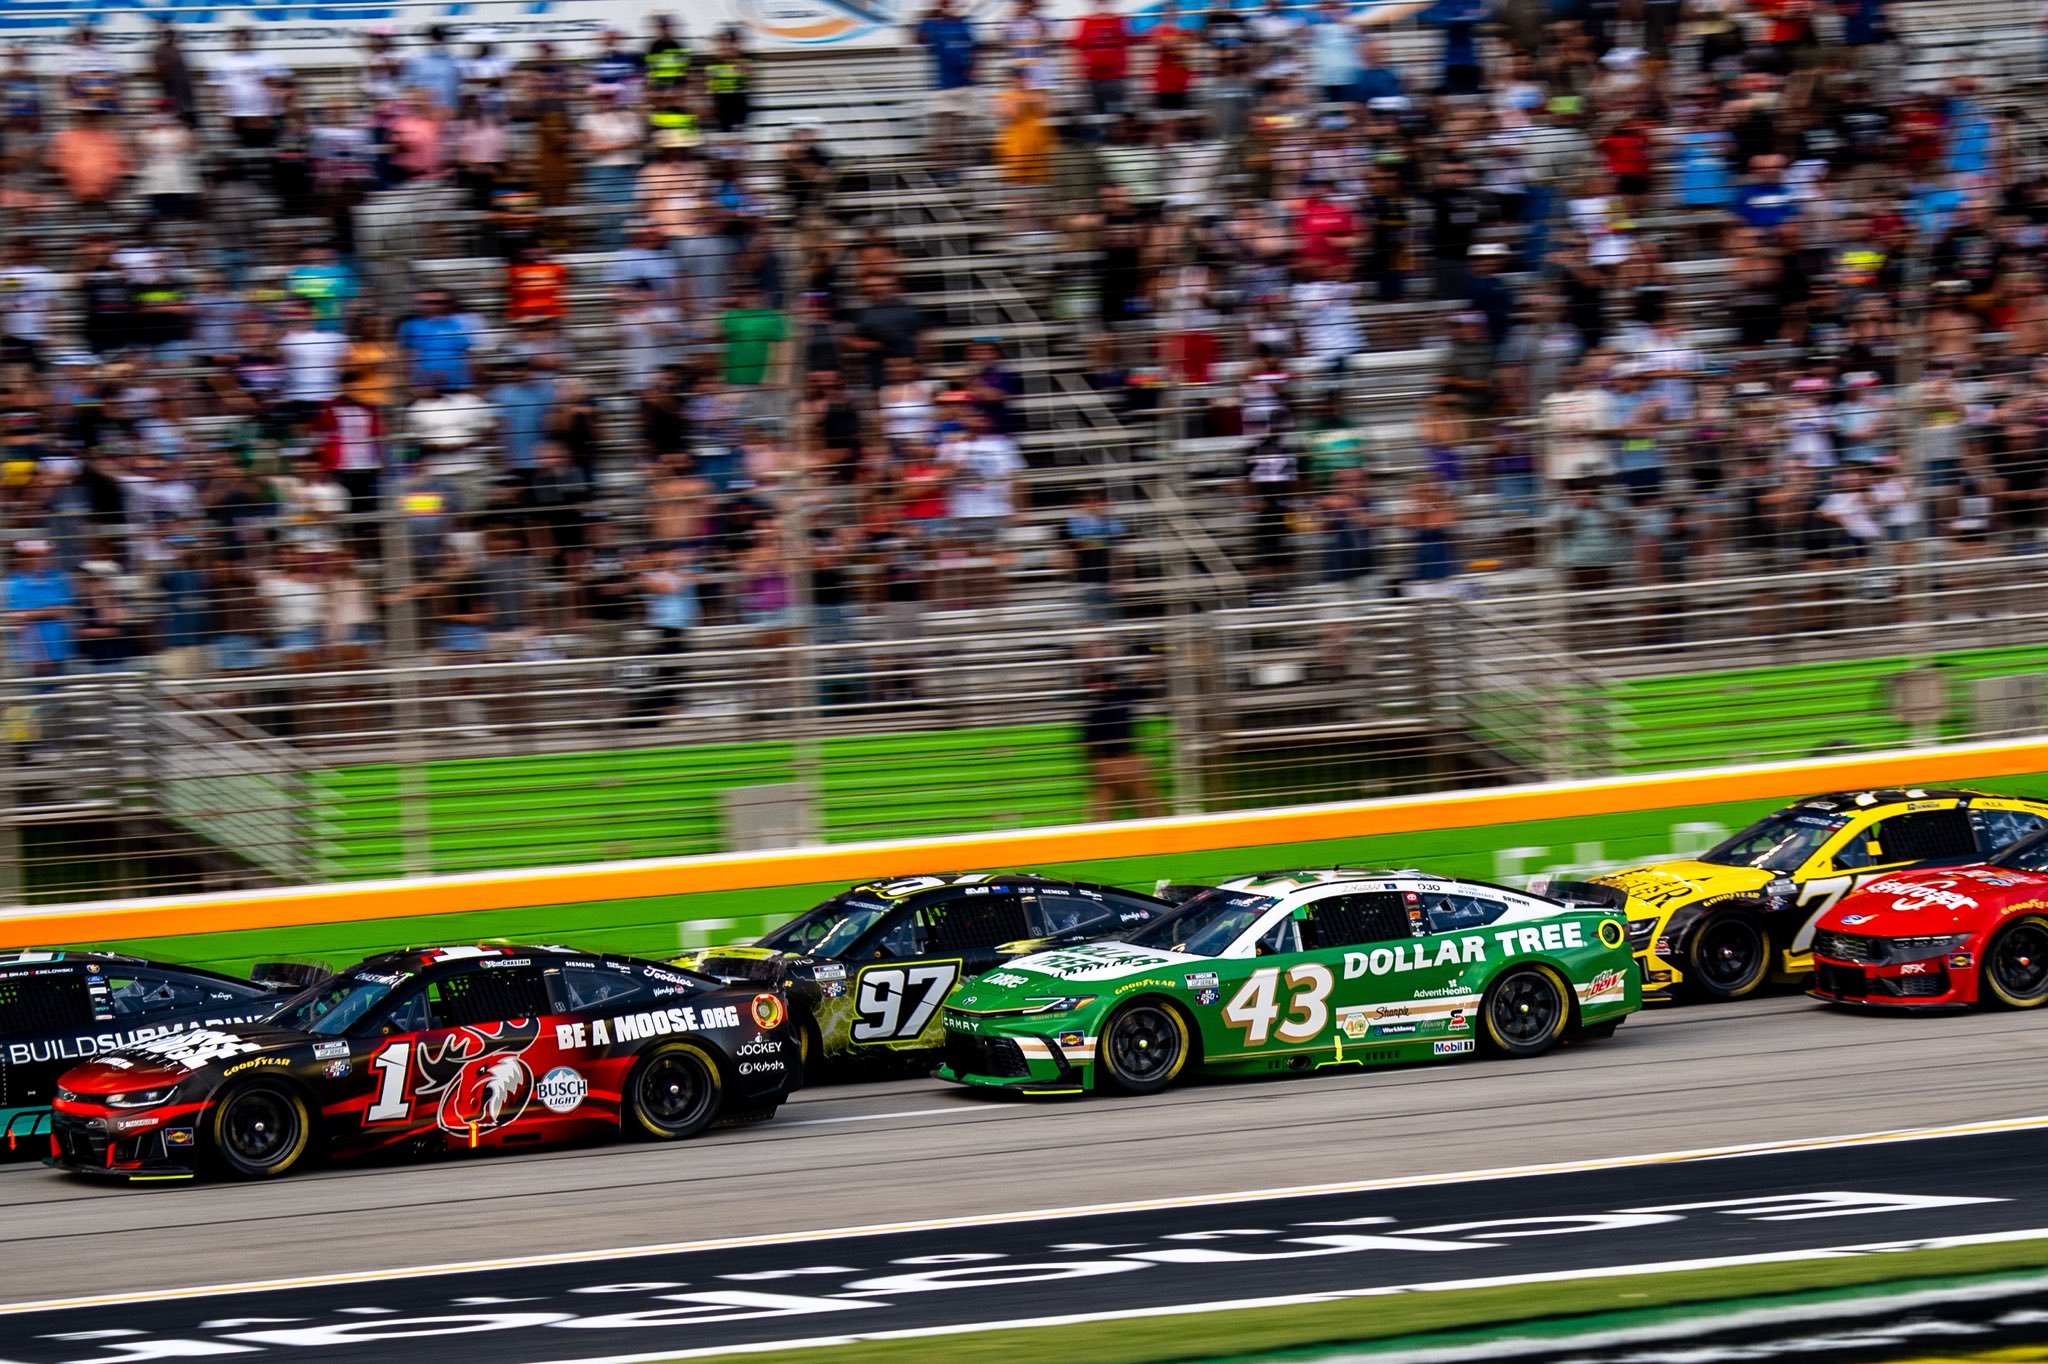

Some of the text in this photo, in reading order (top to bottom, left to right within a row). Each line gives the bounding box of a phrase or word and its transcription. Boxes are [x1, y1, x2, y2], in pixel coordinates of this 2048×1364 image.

[1702, 891, 1760, 907] GOODYEAR
[1791, 873, 1884, 954] 7
[1343, 921, 1584, 979] DOLLAR TREE
[564, 961, 596, 969] SIEMENS
[1114, 979, 1176, 995] GOODYEAR
[1413, 985, 1472, 998] AdventHealth
[854, 965, 956, 1040] 97
[1222, 963, 1334, 1046] 43
[1373, 1006, 1413, 1021] Sharpie
[556, 1023, 587, 1050] BE
[593, 1019, 611, 1046] A
[614, 1005, 741, 1043] MOOSE.ORG
[944, 1018, 980, 1032] CAMRY
[1381, 1024, 1416, 1034] WorkMoney
[736, 1041, 782, 1056] JOCKEY
[1435, 1041, 1463, 1053] Mobil
[223, 1057, 291, 1077] GOODYEAR
[753, 1060, 785, 1073] Kubota
[366, 1042, 410, 1122] 1
[538, 1081, 587, 1099] BUSCH
[549, 1096, 577, 1106] LIGHT
[0, 1190, 2018, 1364] EchoPar
